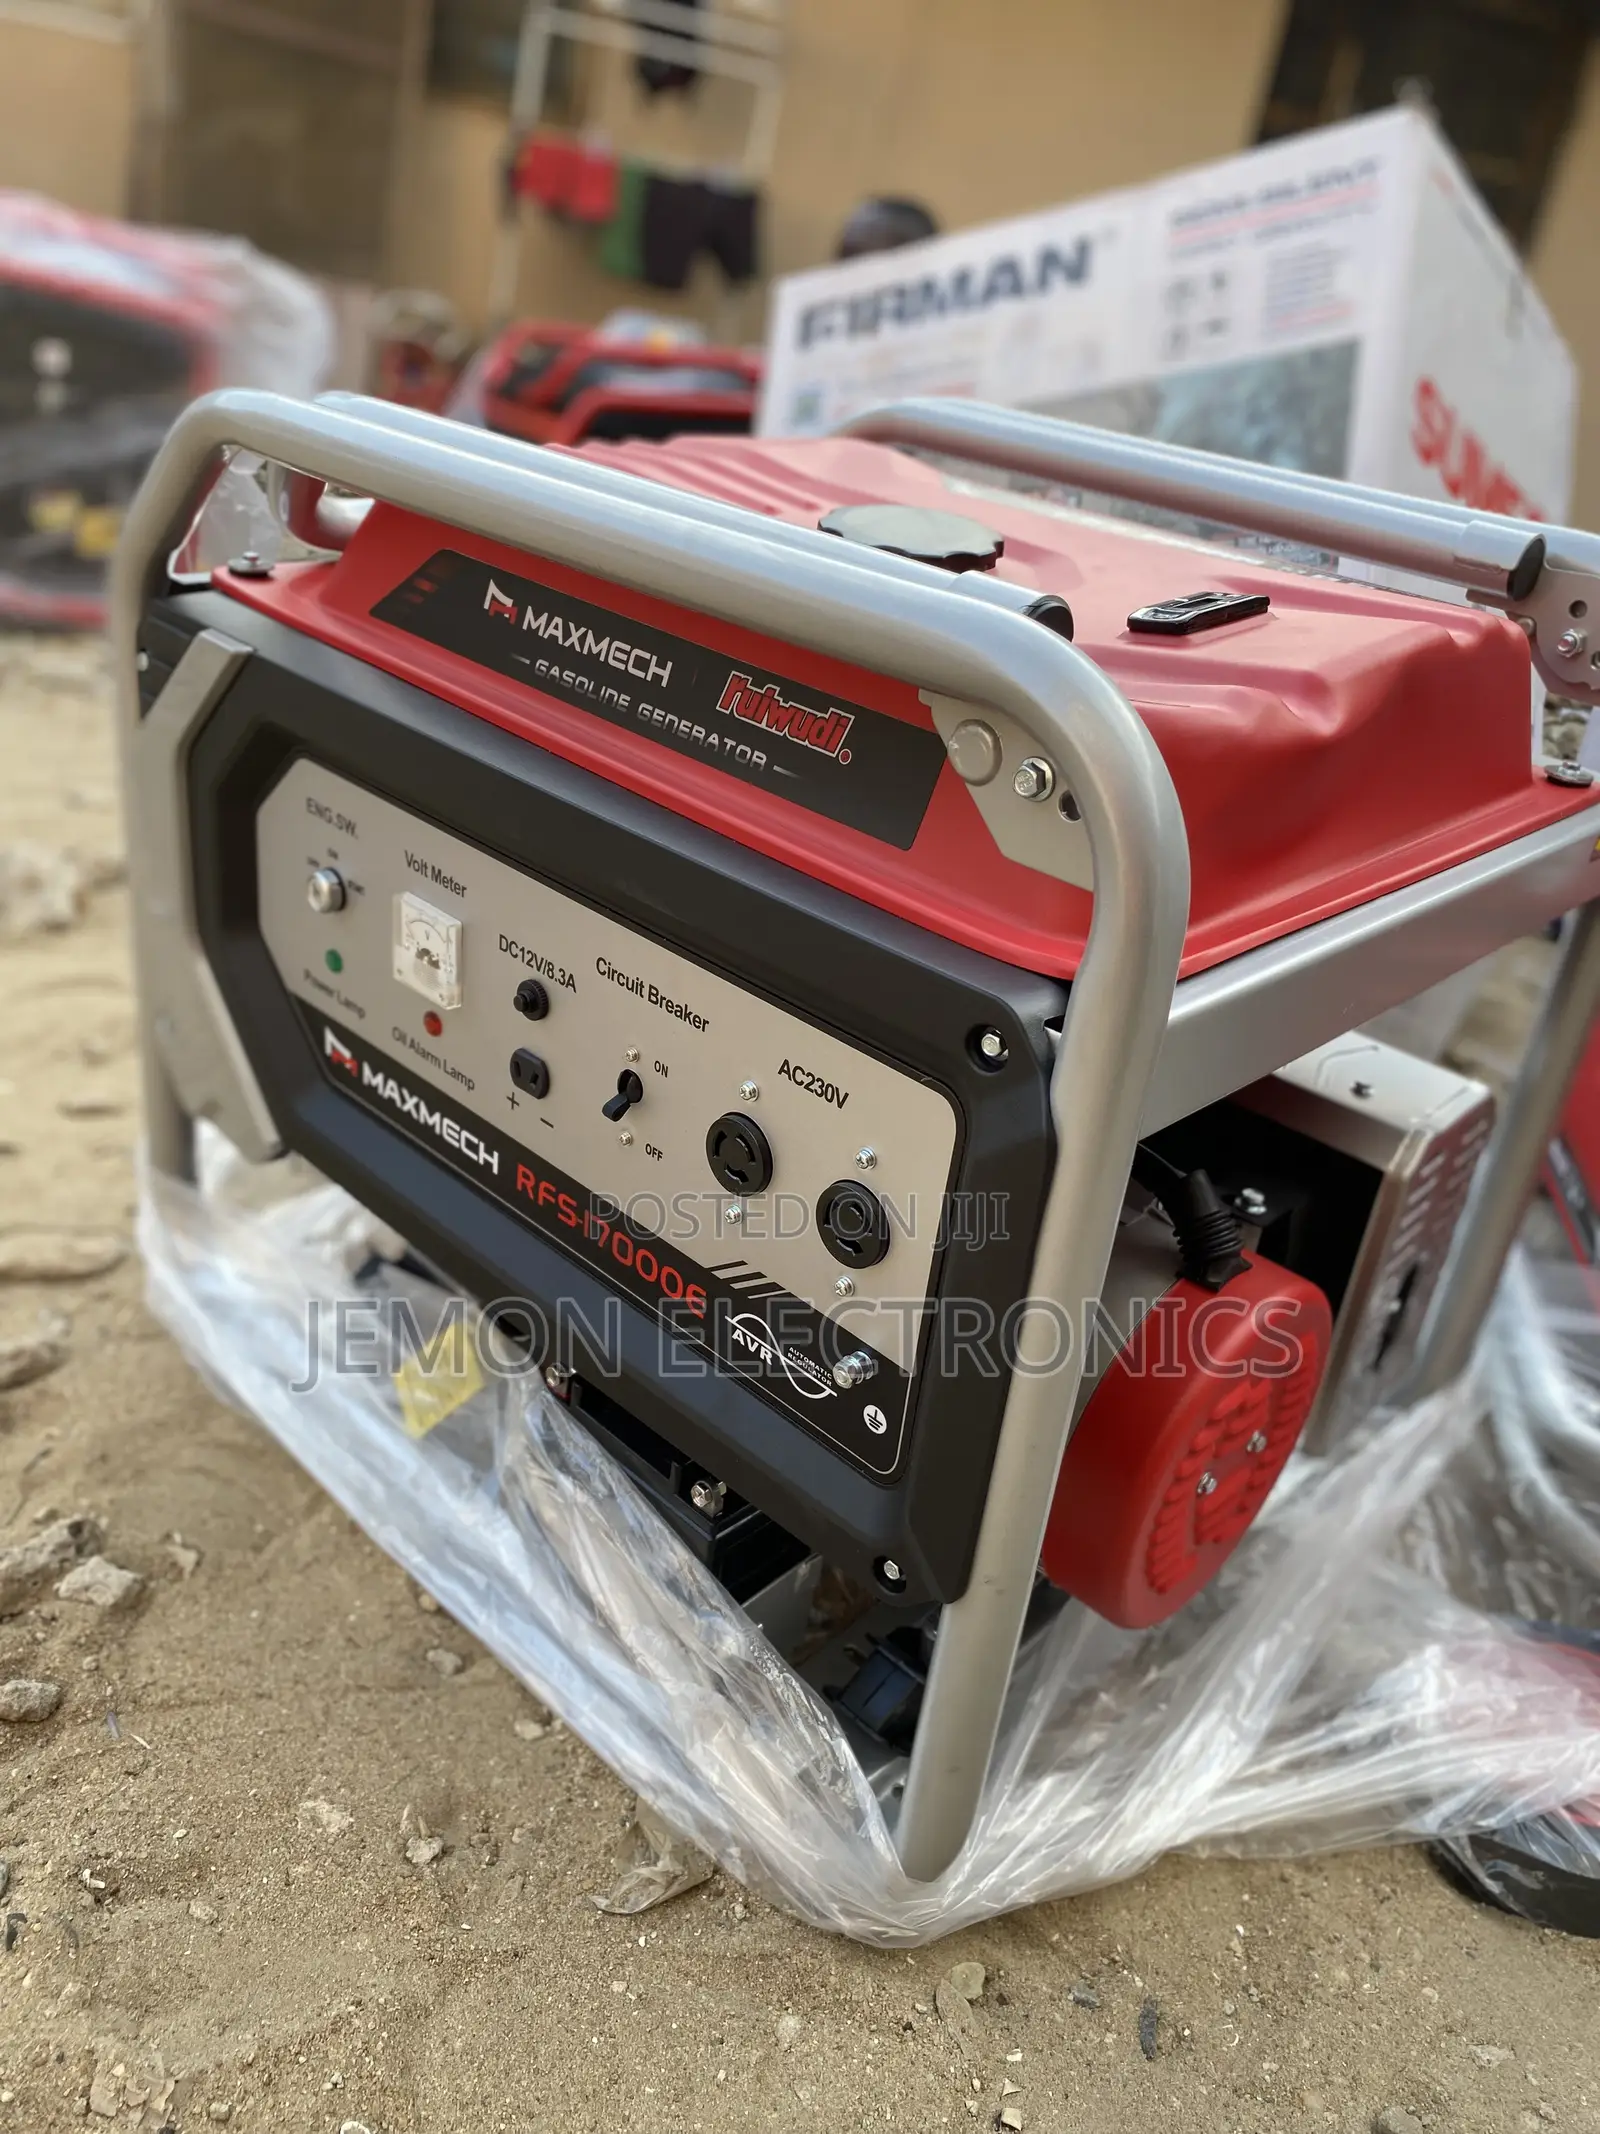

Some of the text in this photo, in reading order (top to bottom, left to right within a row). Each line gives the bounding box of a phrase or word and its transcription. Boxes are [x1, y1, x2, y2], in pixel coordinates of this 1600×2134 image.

[522, 605, 672, 688] MAXMECH
[535, 659, 767, 772] GASOLINE GENERATOR
[404, 849, 467, 898] Volt Meter
[499, 933, 577, 993] DC12V/8.3A
[596, 956, 709, 1033] Circuit Breaker
[392, 1026, 475, 1091] Oil Alarm Lamp
[654, 1060, 669, 1078] ON
[778, 1058, 849, 1110] AC230V
[362, 1060, 499, 1175] MAXMECH
[645, 1143, 663, 1162] OFF
[732, 1329, 772, 1365] AVR
[787, 1352, 833, 1387] REGULATOR
[789, 1346, 833, 1380] AUTOMATIC
